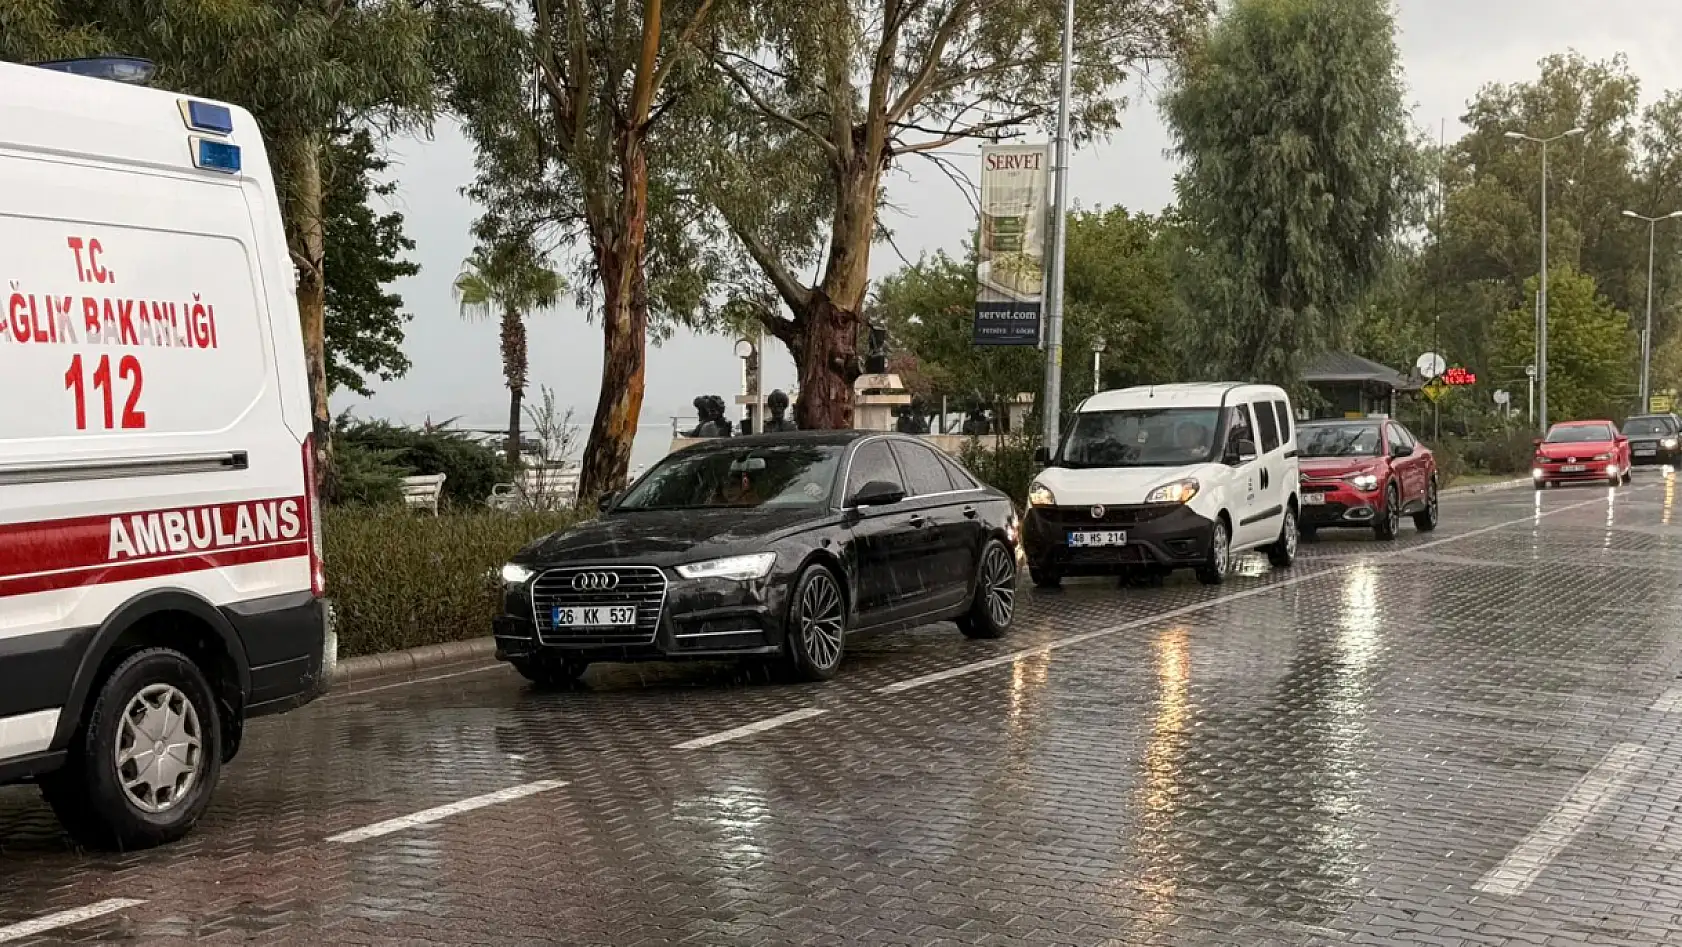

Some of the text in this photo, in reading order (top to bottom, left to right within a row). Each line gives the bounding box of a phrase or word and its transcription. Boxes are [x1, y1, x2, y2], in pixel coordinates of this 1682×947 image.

[986, 152, 1043, 171] SERVET
[67, 236, 115, 283] T.C.
[82, 293, 218, 349] BAKANLIĞI
[979, 310, 1037, 320] servet.com
[64, 354, 146, 429] 112
[107, 500, 301, 560] AMBULANS
[559, 608, 635, 624] 26 KK 537
